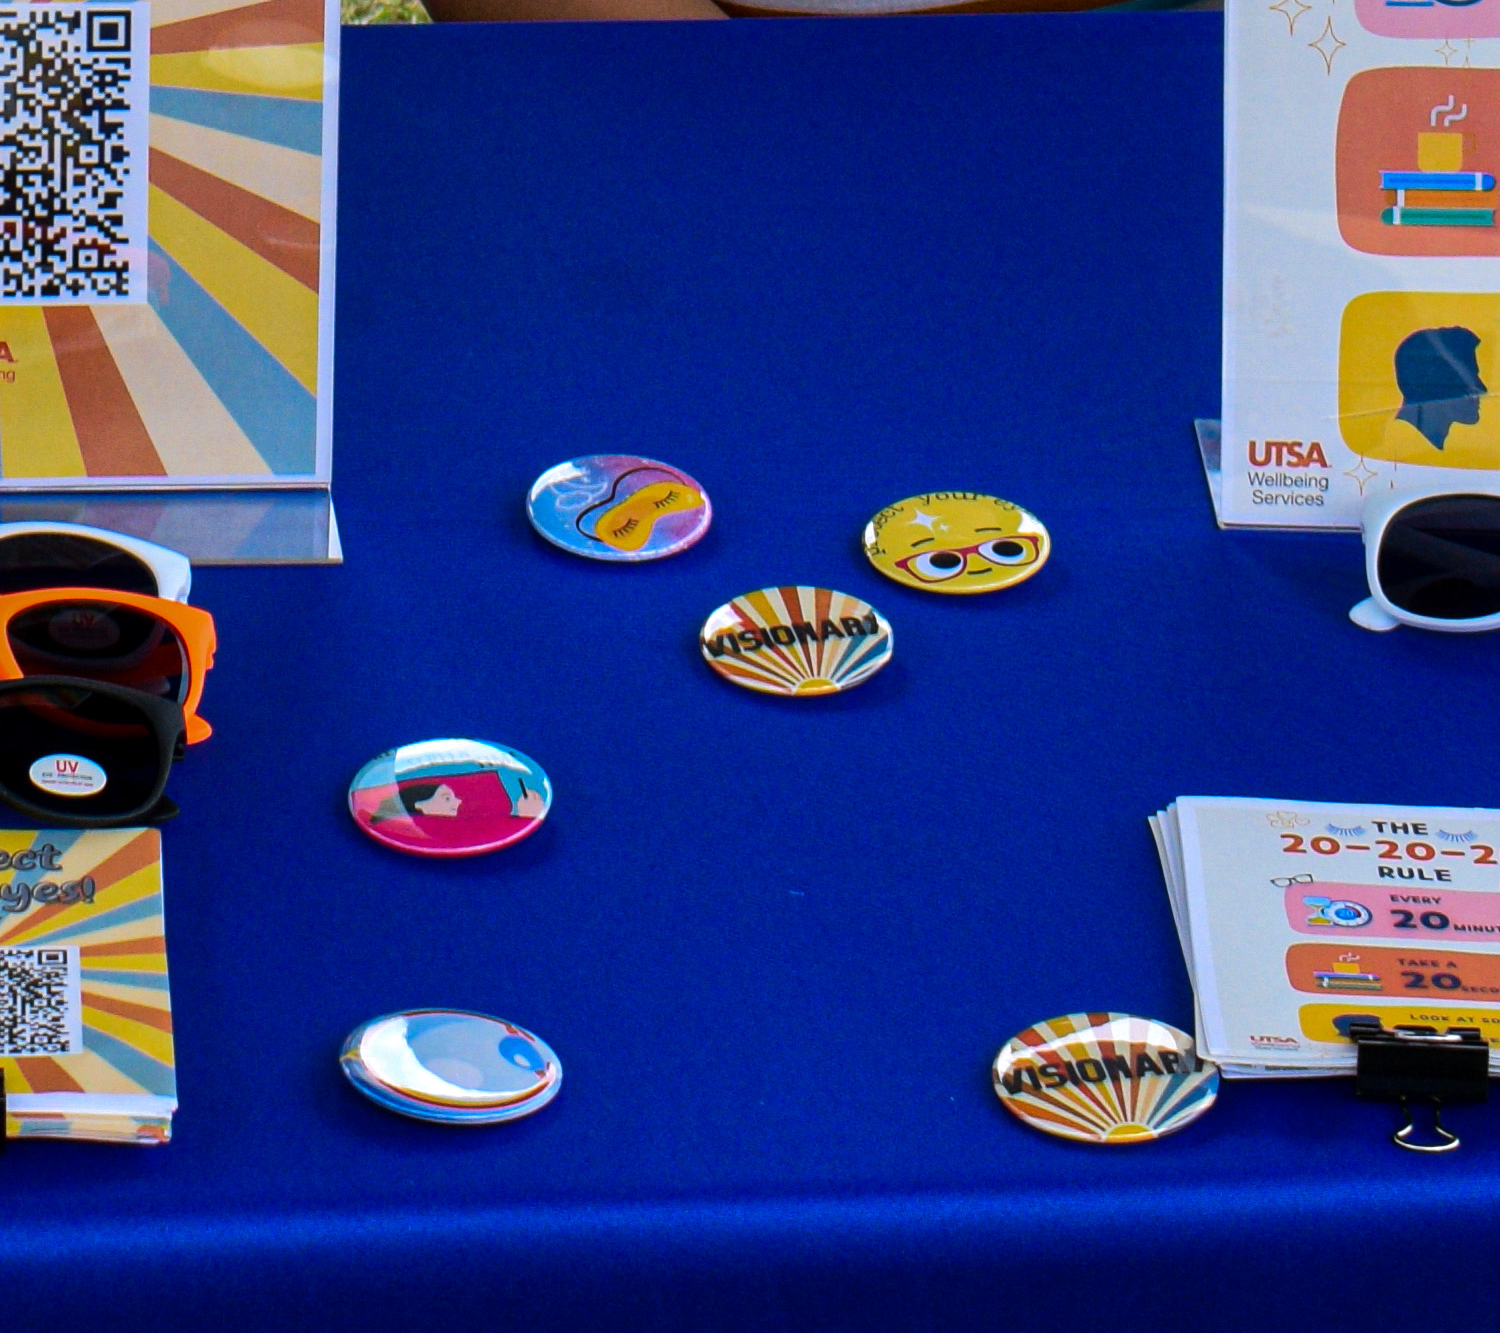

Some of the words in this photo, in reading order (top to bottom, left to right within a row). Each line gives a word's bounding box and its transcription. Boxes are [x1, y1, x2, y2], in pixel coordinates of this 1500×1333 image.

[1248, 440, 1329, 468] UTSA
[1248, 471, 1329, 492] Wellbeing
[1252, 490, 1325, 506] Services
[56, 759, 79, 773] UV
[1372, 820, 1429, 835] THE
[1378, 865, 1452, 882] RULE
[1389, 893, 1442, 905] EVERY
[1389, 909, 1450, 931] 20
[1397, 958, 1439, 968] TAKE
[1448, 960, 1458, 969] A
[1400, 970, 1462, 991] 20
[1410, 1013, 1449, 1022] LOOK
[1456, 1015, 1475, 1023] AT
